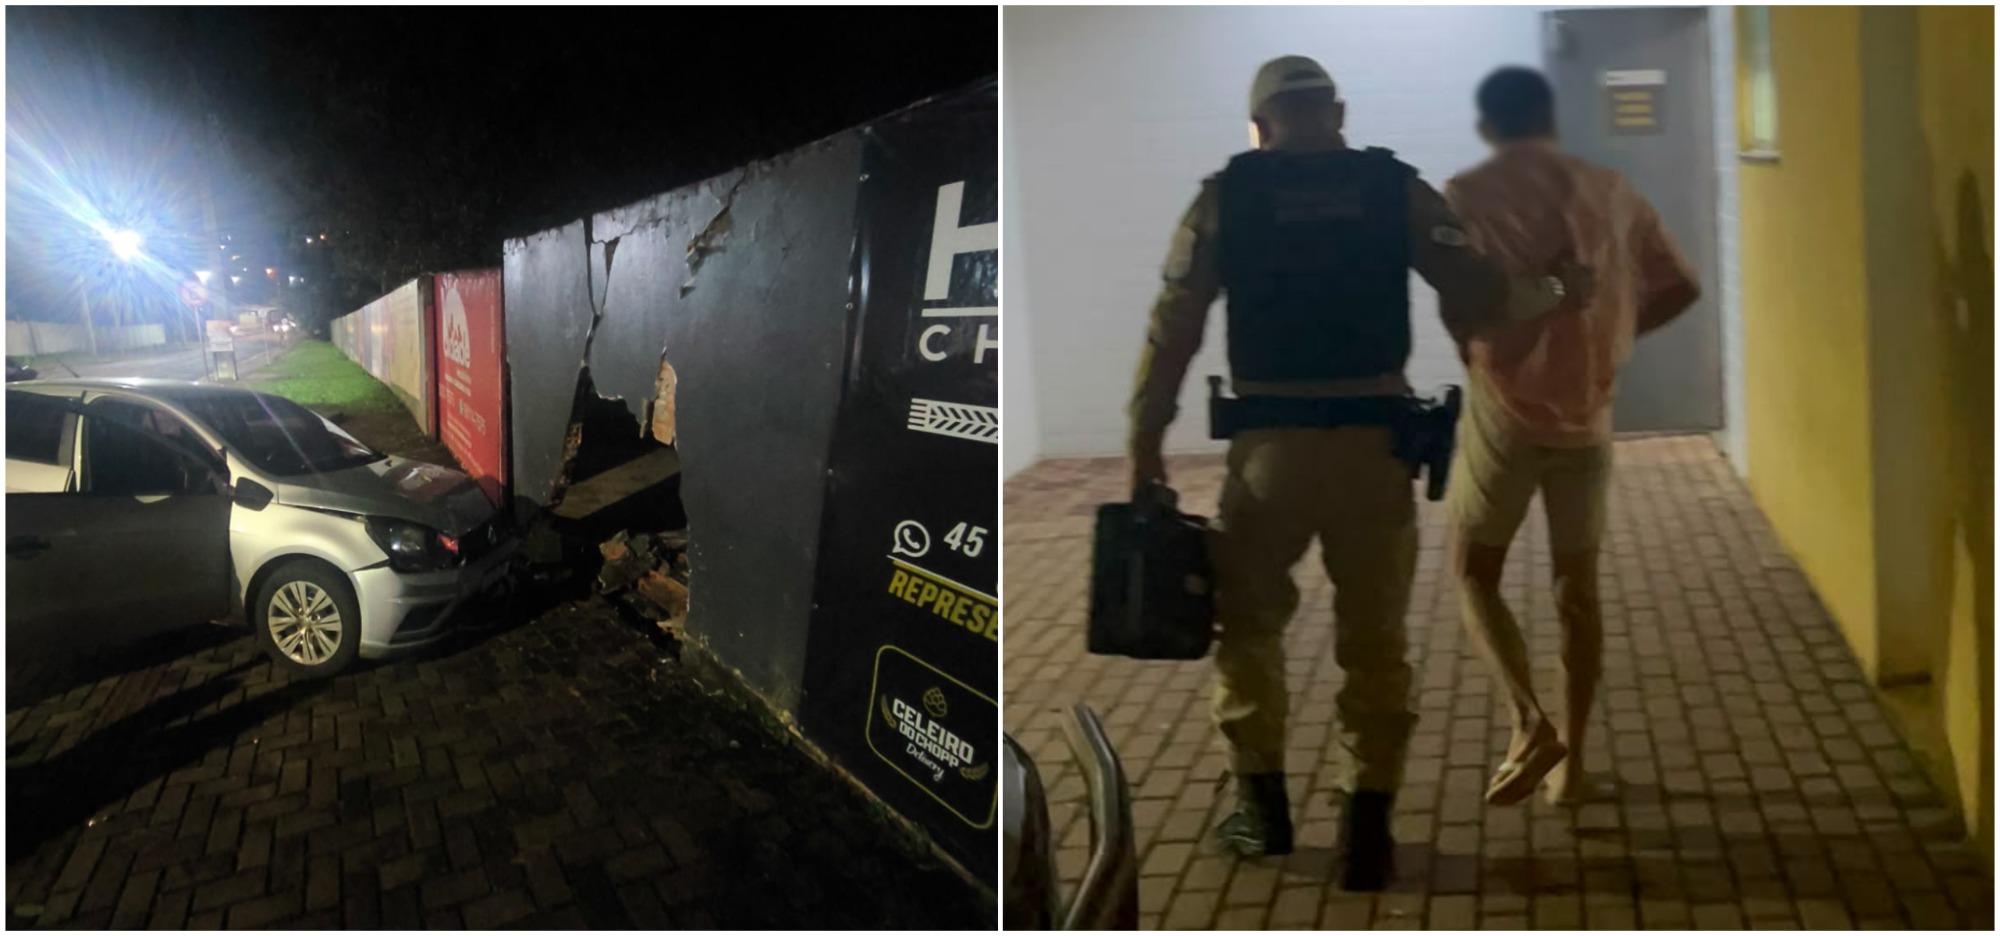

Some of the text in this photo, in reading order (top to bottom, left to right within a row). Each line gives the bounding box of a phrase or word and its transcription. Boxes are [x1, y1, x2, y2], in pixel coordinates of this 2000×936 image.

[943, 521, 988, 558] 45
[887, 568, 998, 643] REPRESE
[893, 698, 974, 765] CELEIRO
[899, 721, 960, 768] DO CHOPP
[906, 743, 945, 782] Delivery
